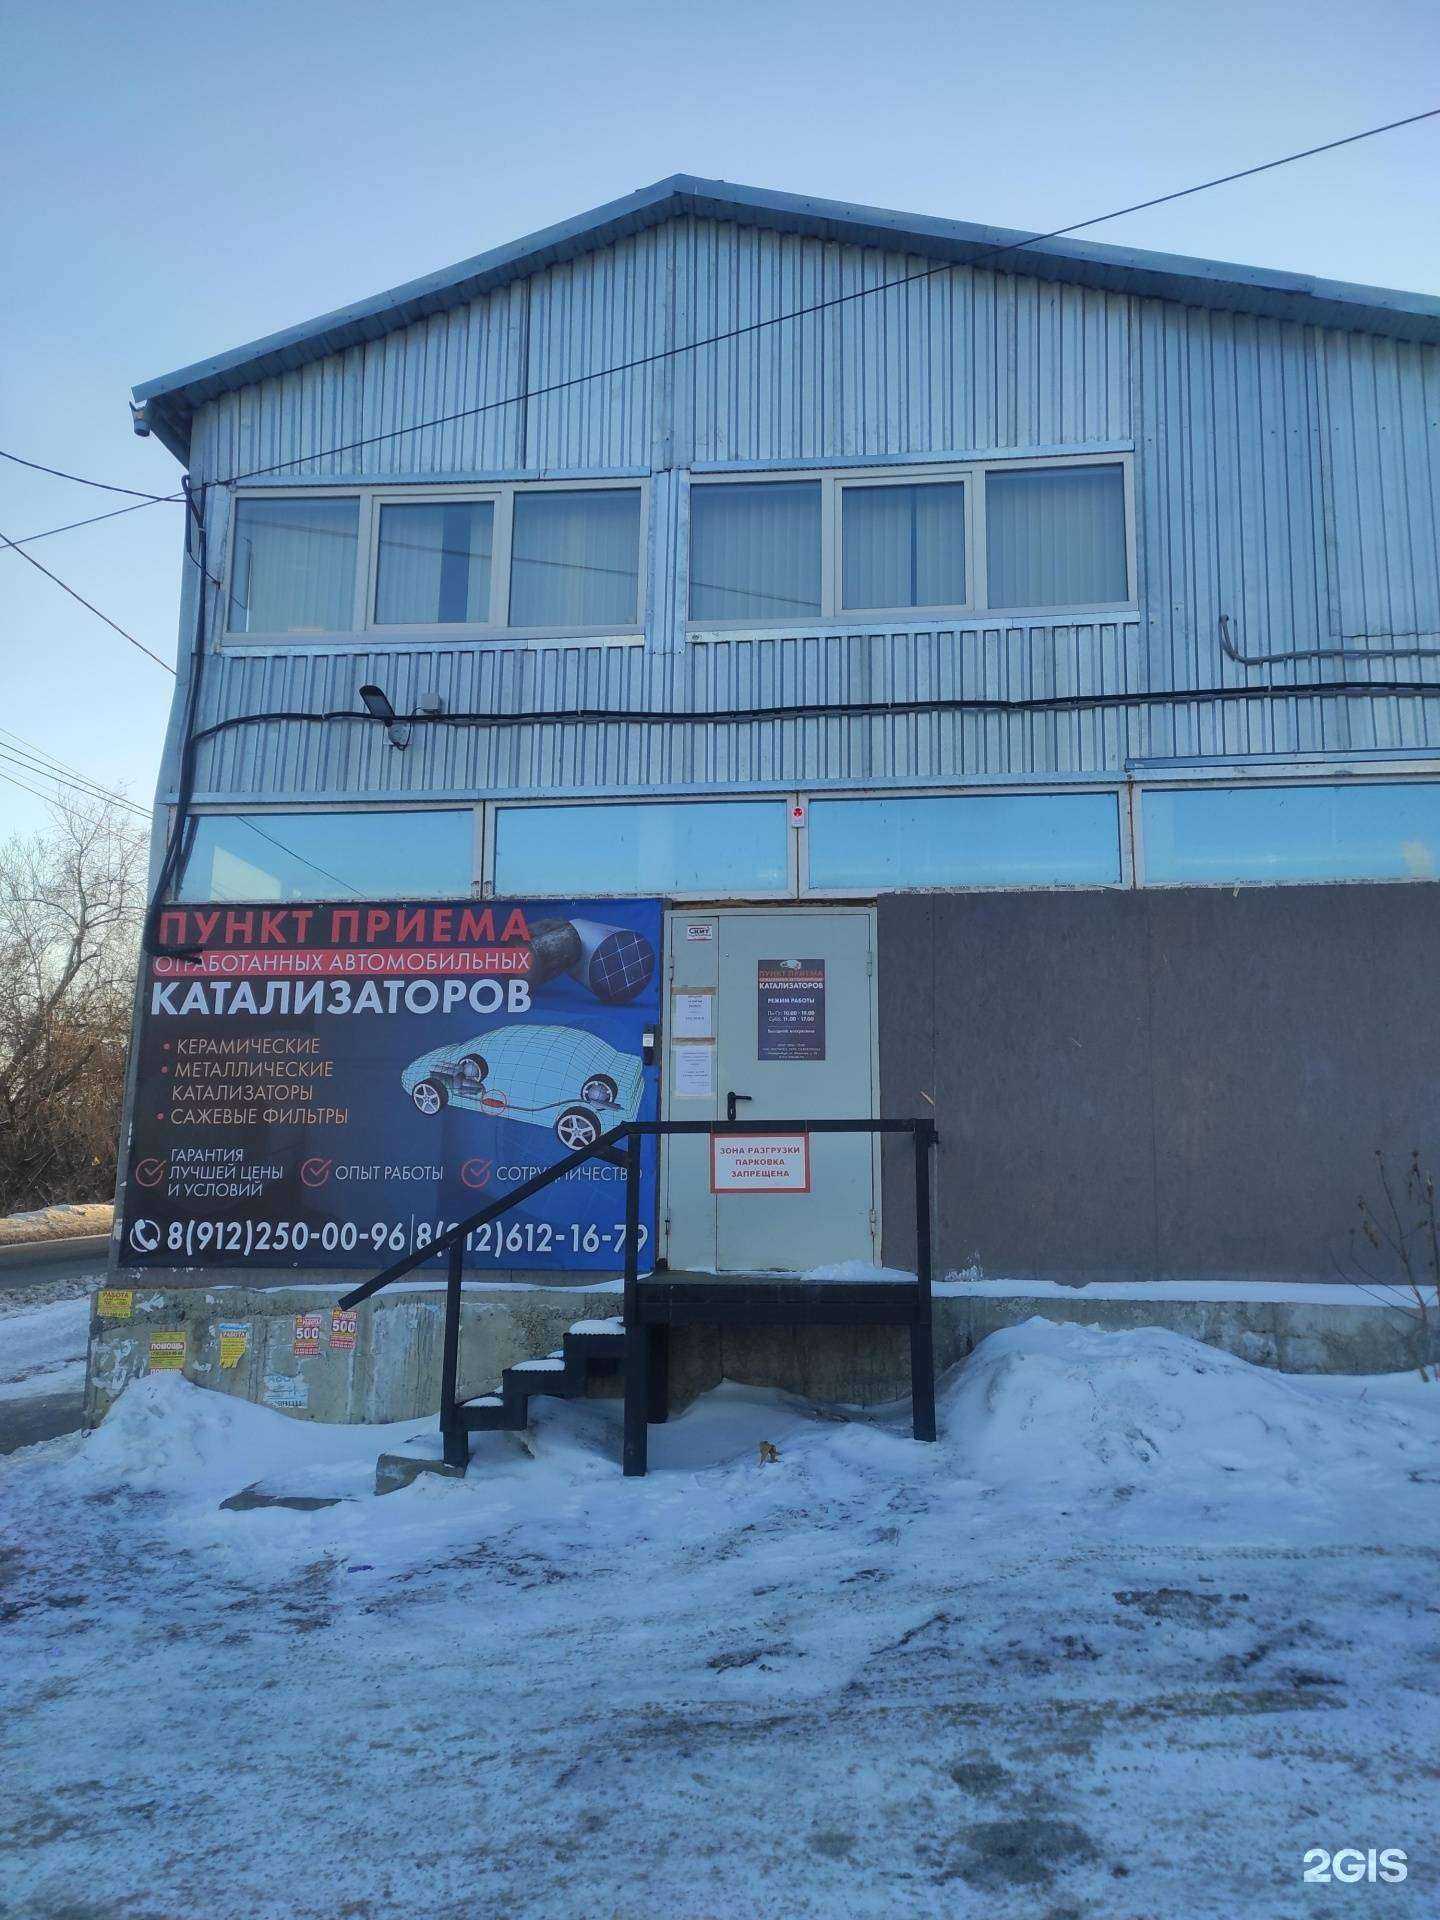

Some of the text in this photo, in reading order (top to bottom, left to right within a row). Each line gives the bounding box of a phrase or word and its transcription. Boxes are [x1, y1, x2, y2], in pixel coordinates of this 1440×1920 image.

[159, 909, 531, 945] ПУНКТ ПРИЕМА
[155, 952, 530, 972] ОТРАБОТАННЫХ АВТОМОБИЛЬНЫХ
[150, 979, 532, 1016] КАТАЛИЗАТОРОВ
[177, 1038, 320, 1054] КЕРАМИЧЕСКИЕ
[174, 1061, 334, 1078] МЕТАЛЛИЧЕСКИЕ
[172, 1085, 313, 1101] КАТАЛИЗАТОРЫ
[170, 1107, 349, 1125] САЖЕВЫЕ ФИЛЬТРЫ
[171, 1149, 244, 1162] ГАРАНТИЯ
[720, 1146, 800, 1155] ЗОНА РАЗГРУЗКИ
[169, 1164, 284, 1181] ЛУЧШЕЙ ЦЕНЫ
[335, 1166, 444, 1180] ОПЫТ РАБОТЫ
[496, 1166, 643, 1183] СОТРНИЧЕСТВ
[731, 1170, 789, 1178] ЗАПРЕЩЕНА
[168, 1181, 263, 1197] И УСЛОВИЙ
[167, 1220, 405, 1256] 8(912)250-00-96
[296, 1328, 319, 1339] 500
[332, 1320, 356, 1332] 500
